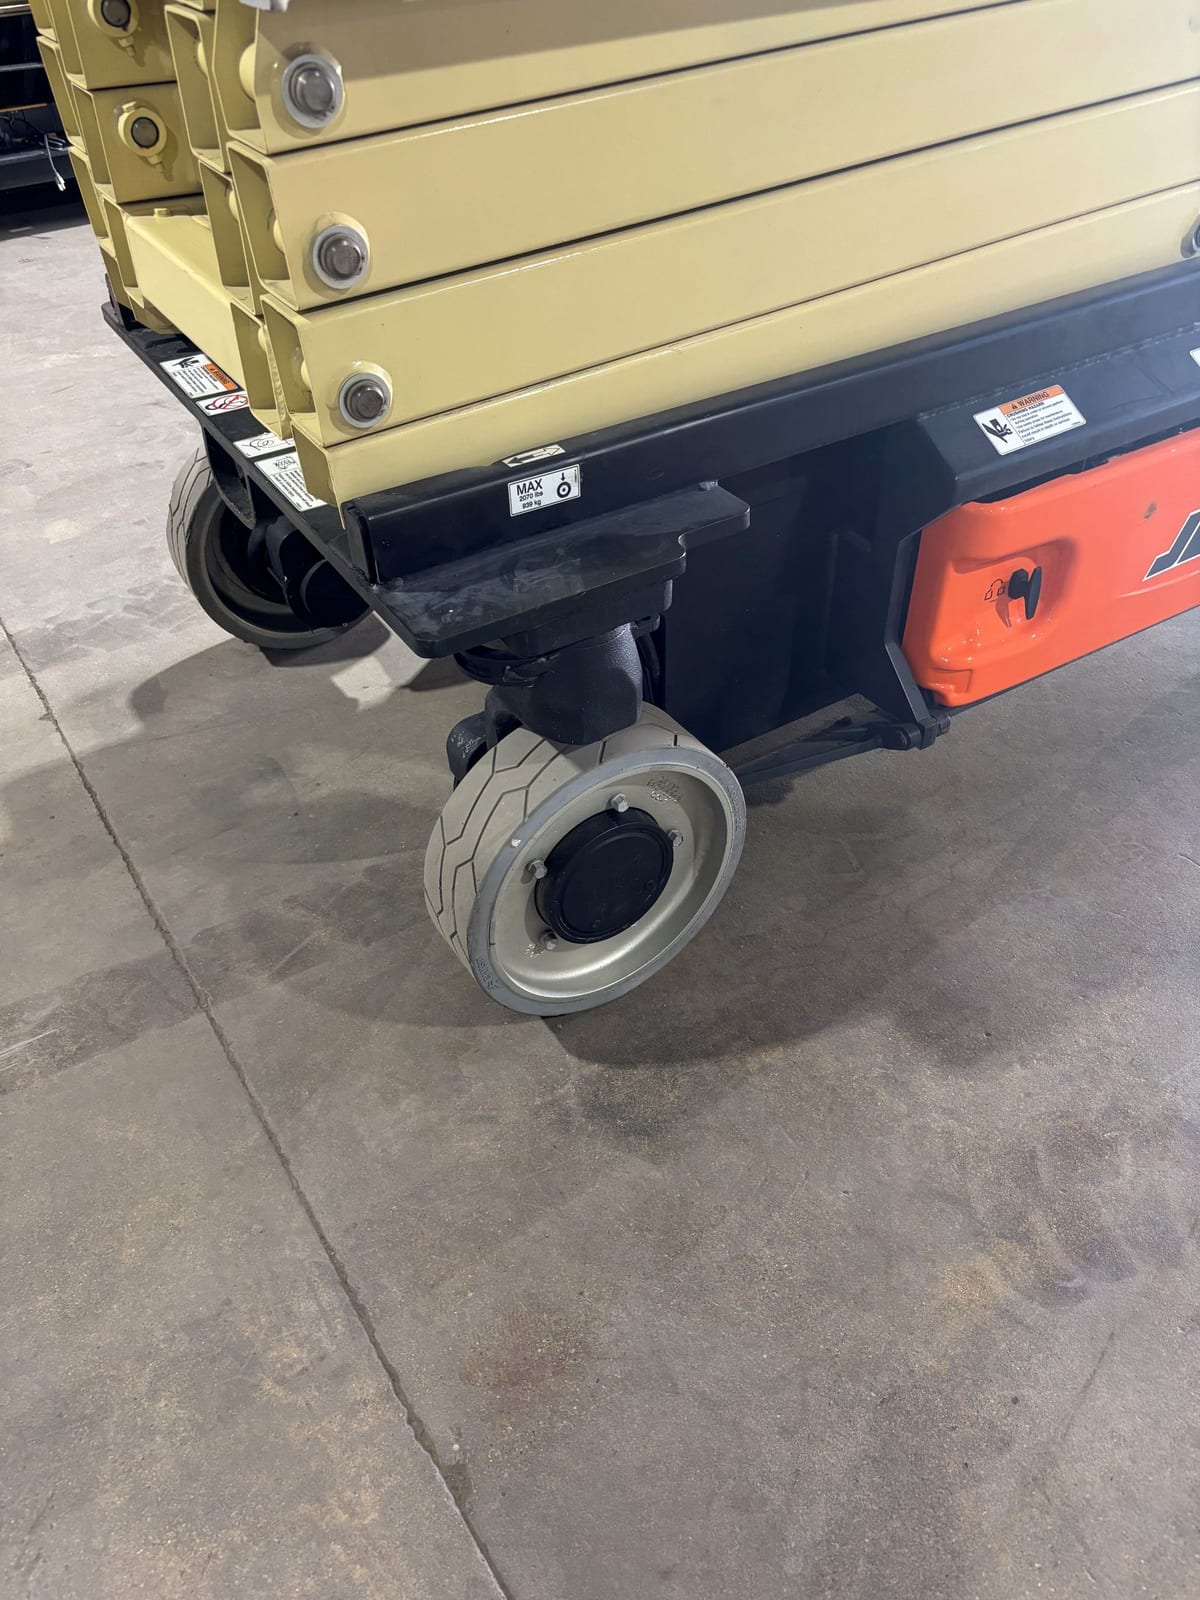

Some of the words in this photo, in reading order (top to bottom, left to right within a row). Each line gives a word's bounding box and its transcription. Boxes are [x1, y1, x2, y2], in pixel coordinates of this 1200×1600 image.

[1017, 391, 1050, 407] WARNING
[516, 478, 543, 496] MAX
[519, 493, 534, 502] 2070
[534, 490, 544, 498] lbs
